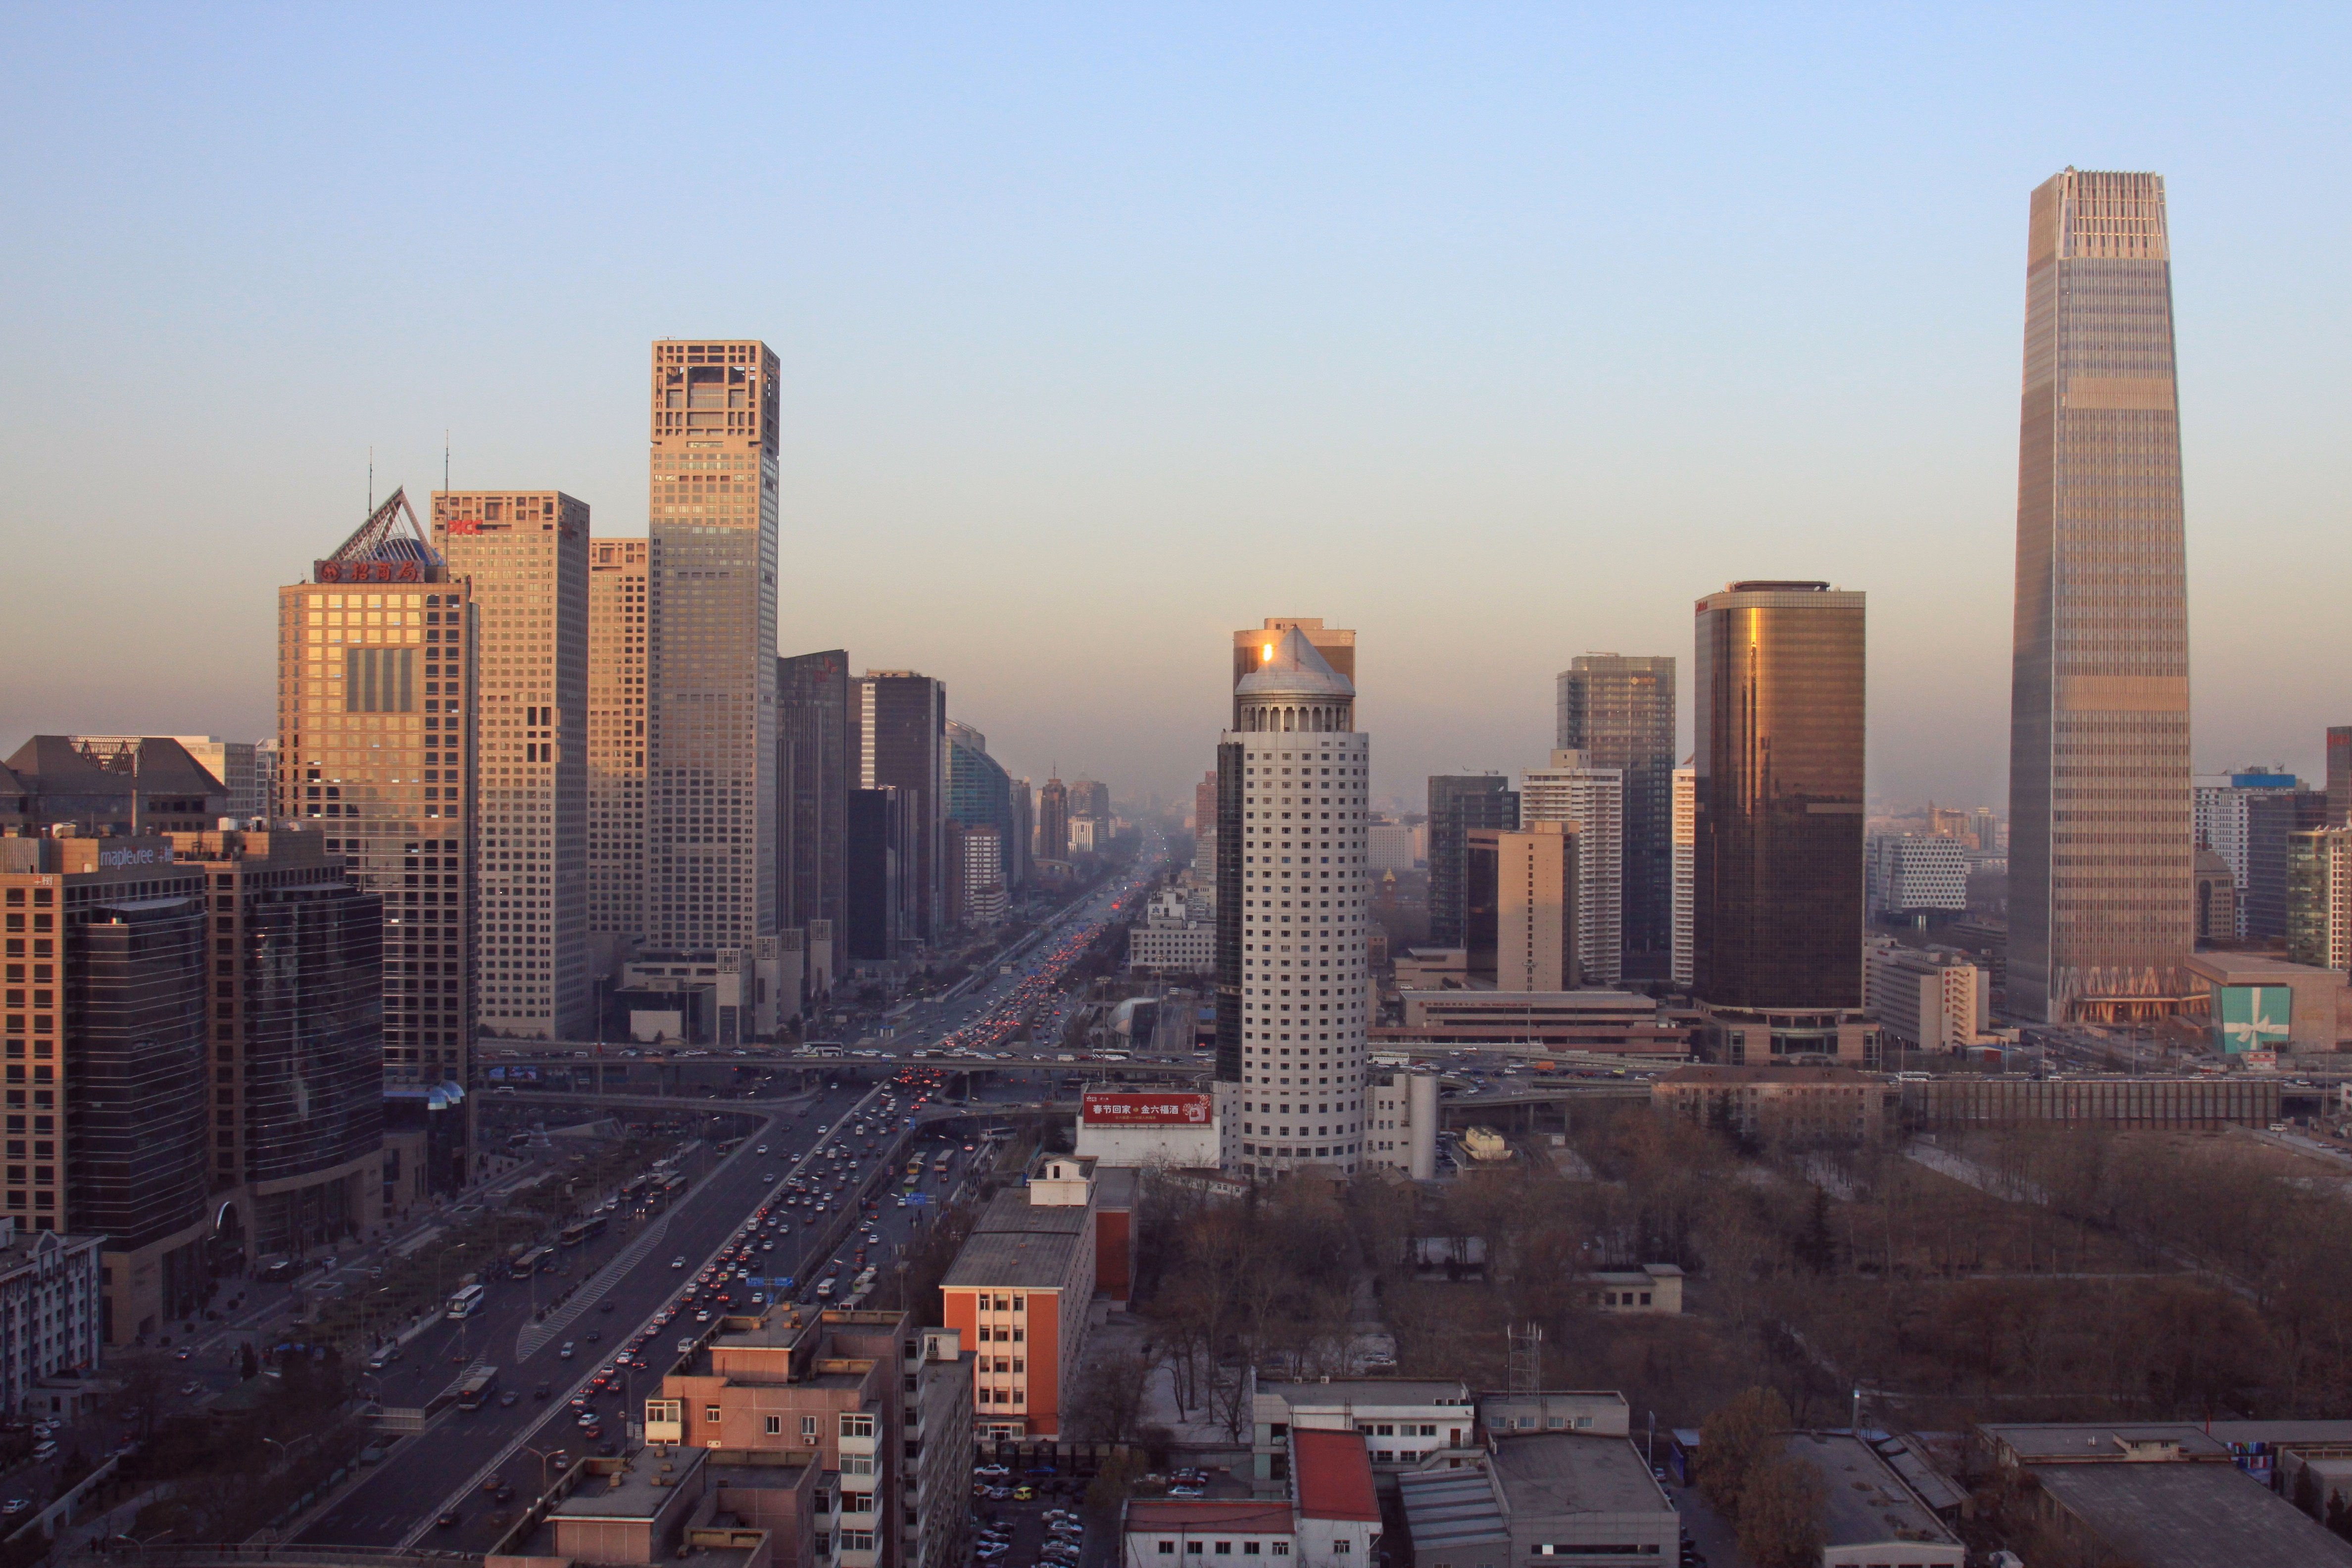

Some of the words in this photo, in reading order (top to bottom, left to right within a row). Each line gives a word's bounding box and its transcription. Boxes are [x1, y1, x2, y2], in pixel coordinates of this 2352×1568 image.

[447, 519, 483, 535] PICC
[351, 561, 417, 581] 招商局
[100, 847, 153, 870] mapletree
[1093, 1105, 1131, 1114] 春节回家
[1141, 1105, 1178, 1114] 金六福酒
